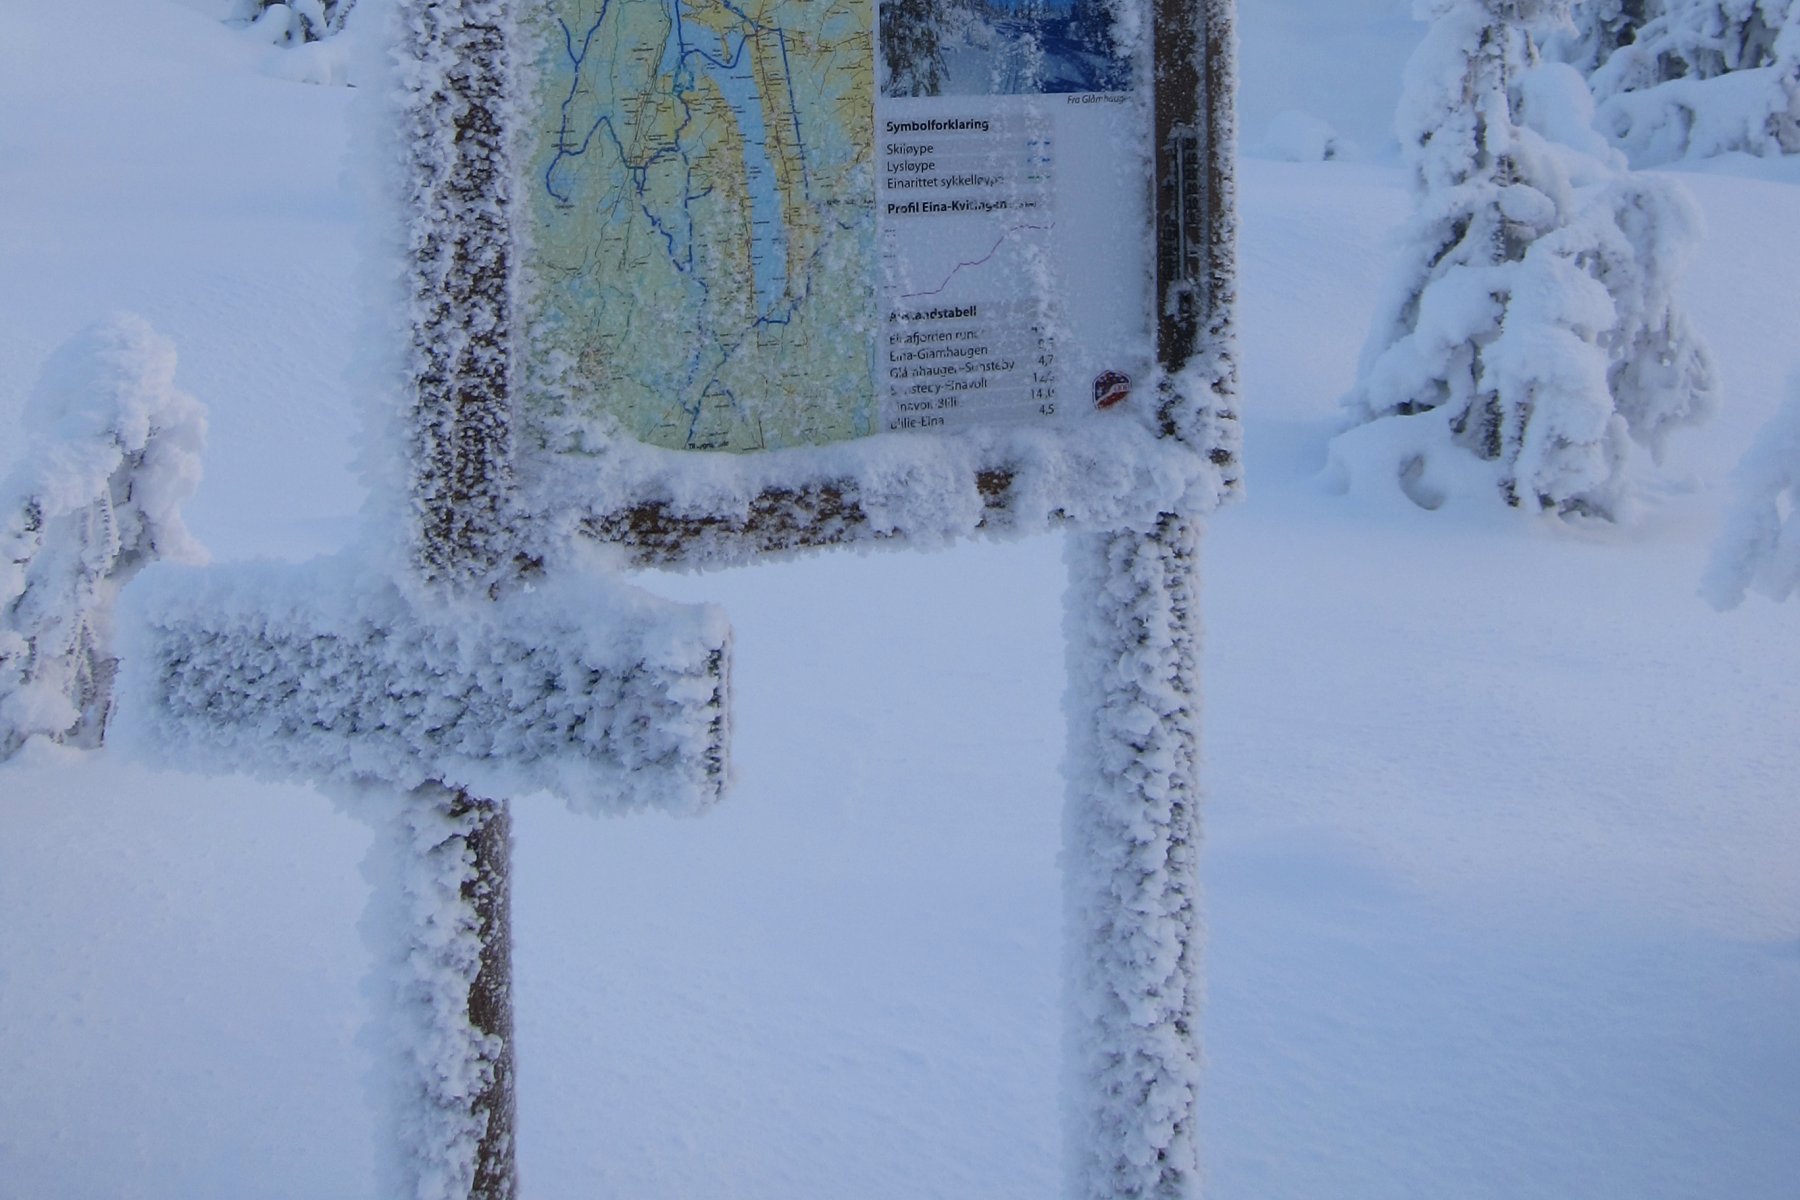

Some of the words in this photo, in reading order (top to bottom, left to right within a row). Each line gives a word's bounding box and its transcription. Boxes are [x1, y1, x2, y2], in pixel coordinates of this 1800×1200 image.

[1066, 95, 1081, 104] Fra
[886, 118, 989, 133] Symbolforklaring
[886, 142, 934, 156] Skiløype
[887, 161, 936, 173] Lysløype
[887, 176, 939, 189] Einarittet
[888, 202, 919, 214] Profil
[889, 305, 977, 322] Asandstabell
[889, 332, 952, 345] Eiafjorden
[1039, 403, 1055, 415] 4,5
